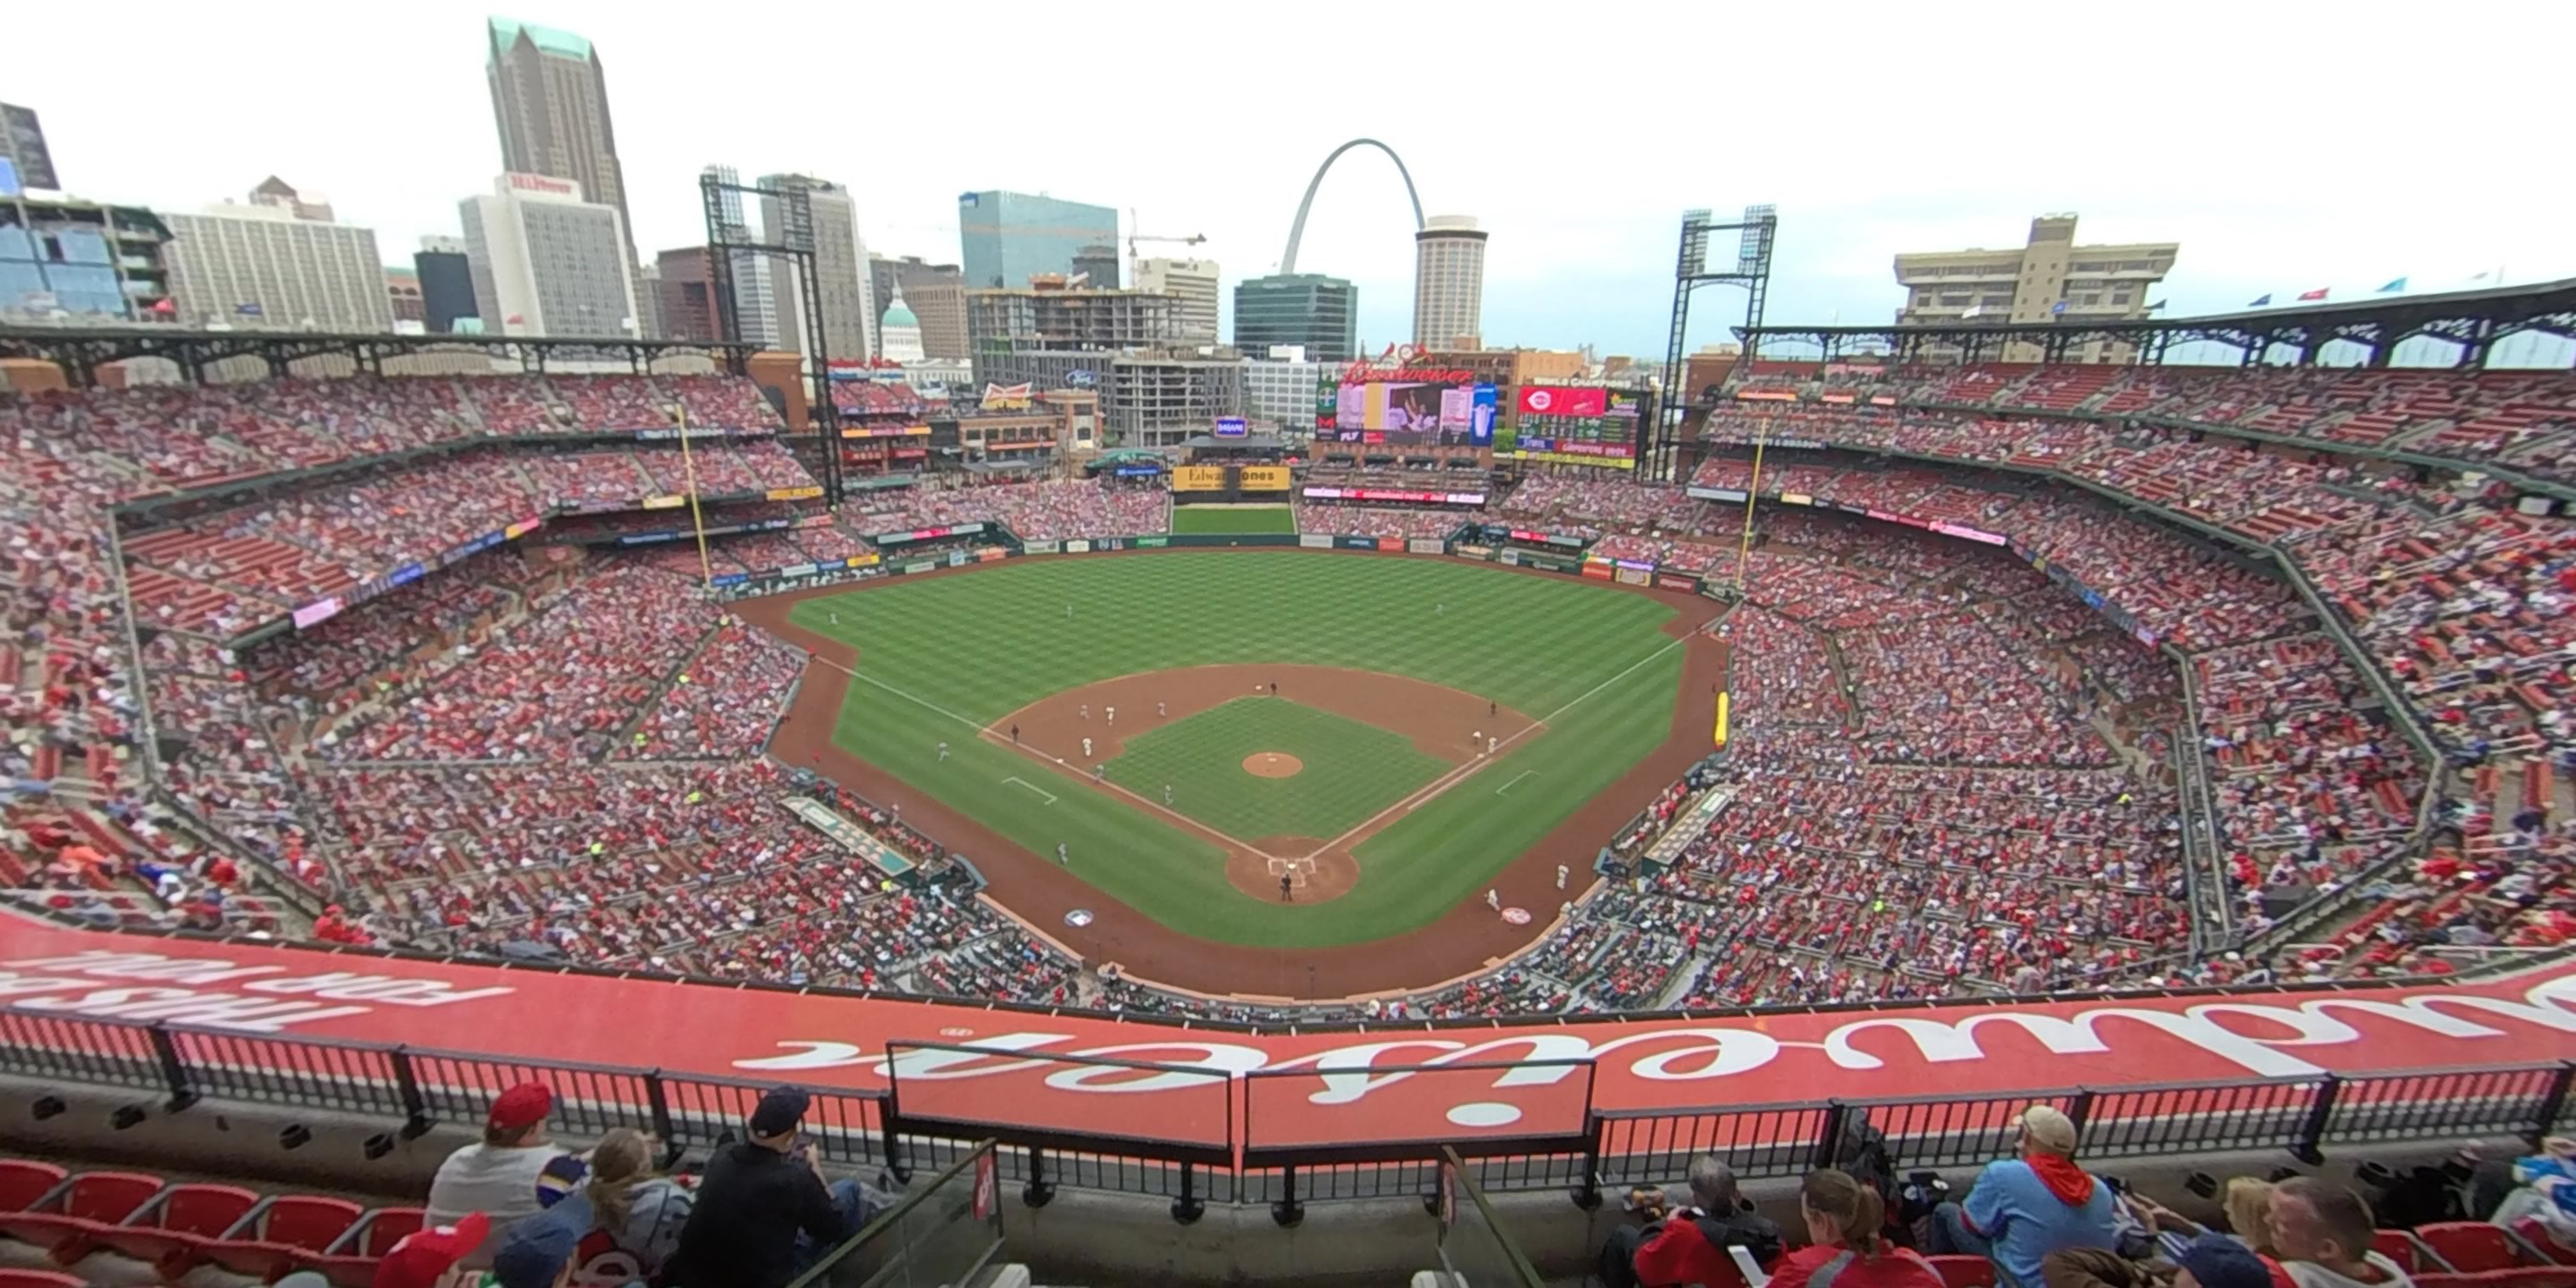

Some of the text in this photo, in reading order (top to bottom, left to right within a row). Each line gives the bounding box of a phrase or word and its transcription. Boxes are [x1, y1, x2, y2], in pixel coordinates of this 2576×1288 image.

[1341, 361, 1474, 387] Budweiser
[1534, 377, 1632, 389] WORLD CHAMPIONS
[1188, 468, 1275, 481] Edwar ones
[242, 971, 518, 1007] FOR
[12, 987, 375, 1032] THIS
